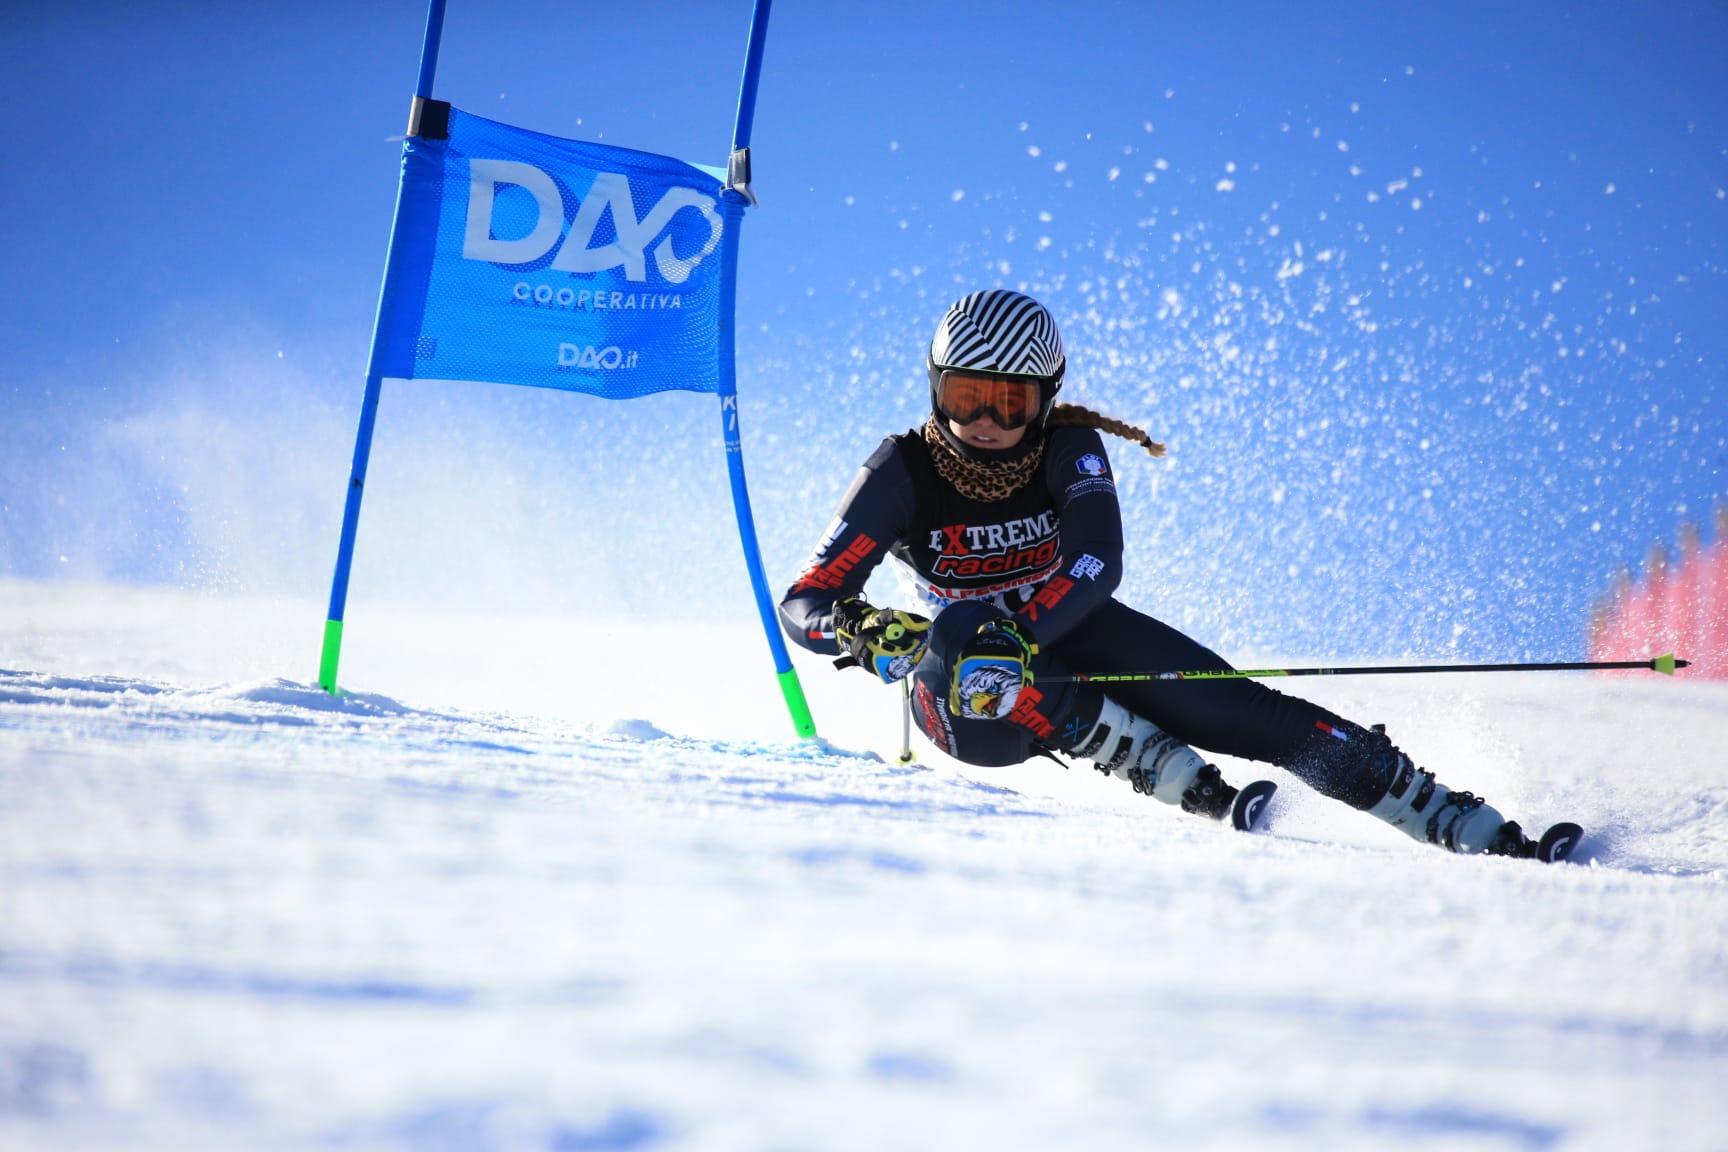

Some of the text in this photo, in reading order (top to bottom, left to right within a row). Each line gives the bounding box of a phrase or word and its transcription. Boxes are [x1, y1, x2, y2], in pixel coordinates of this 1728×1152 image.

[462, 158, 724, 284] DAO
[513, 281, 682, 310] COOPERATIVA
[557, 342, 639, 370] DAO.it
[938, 538, 1058, 575] racing
